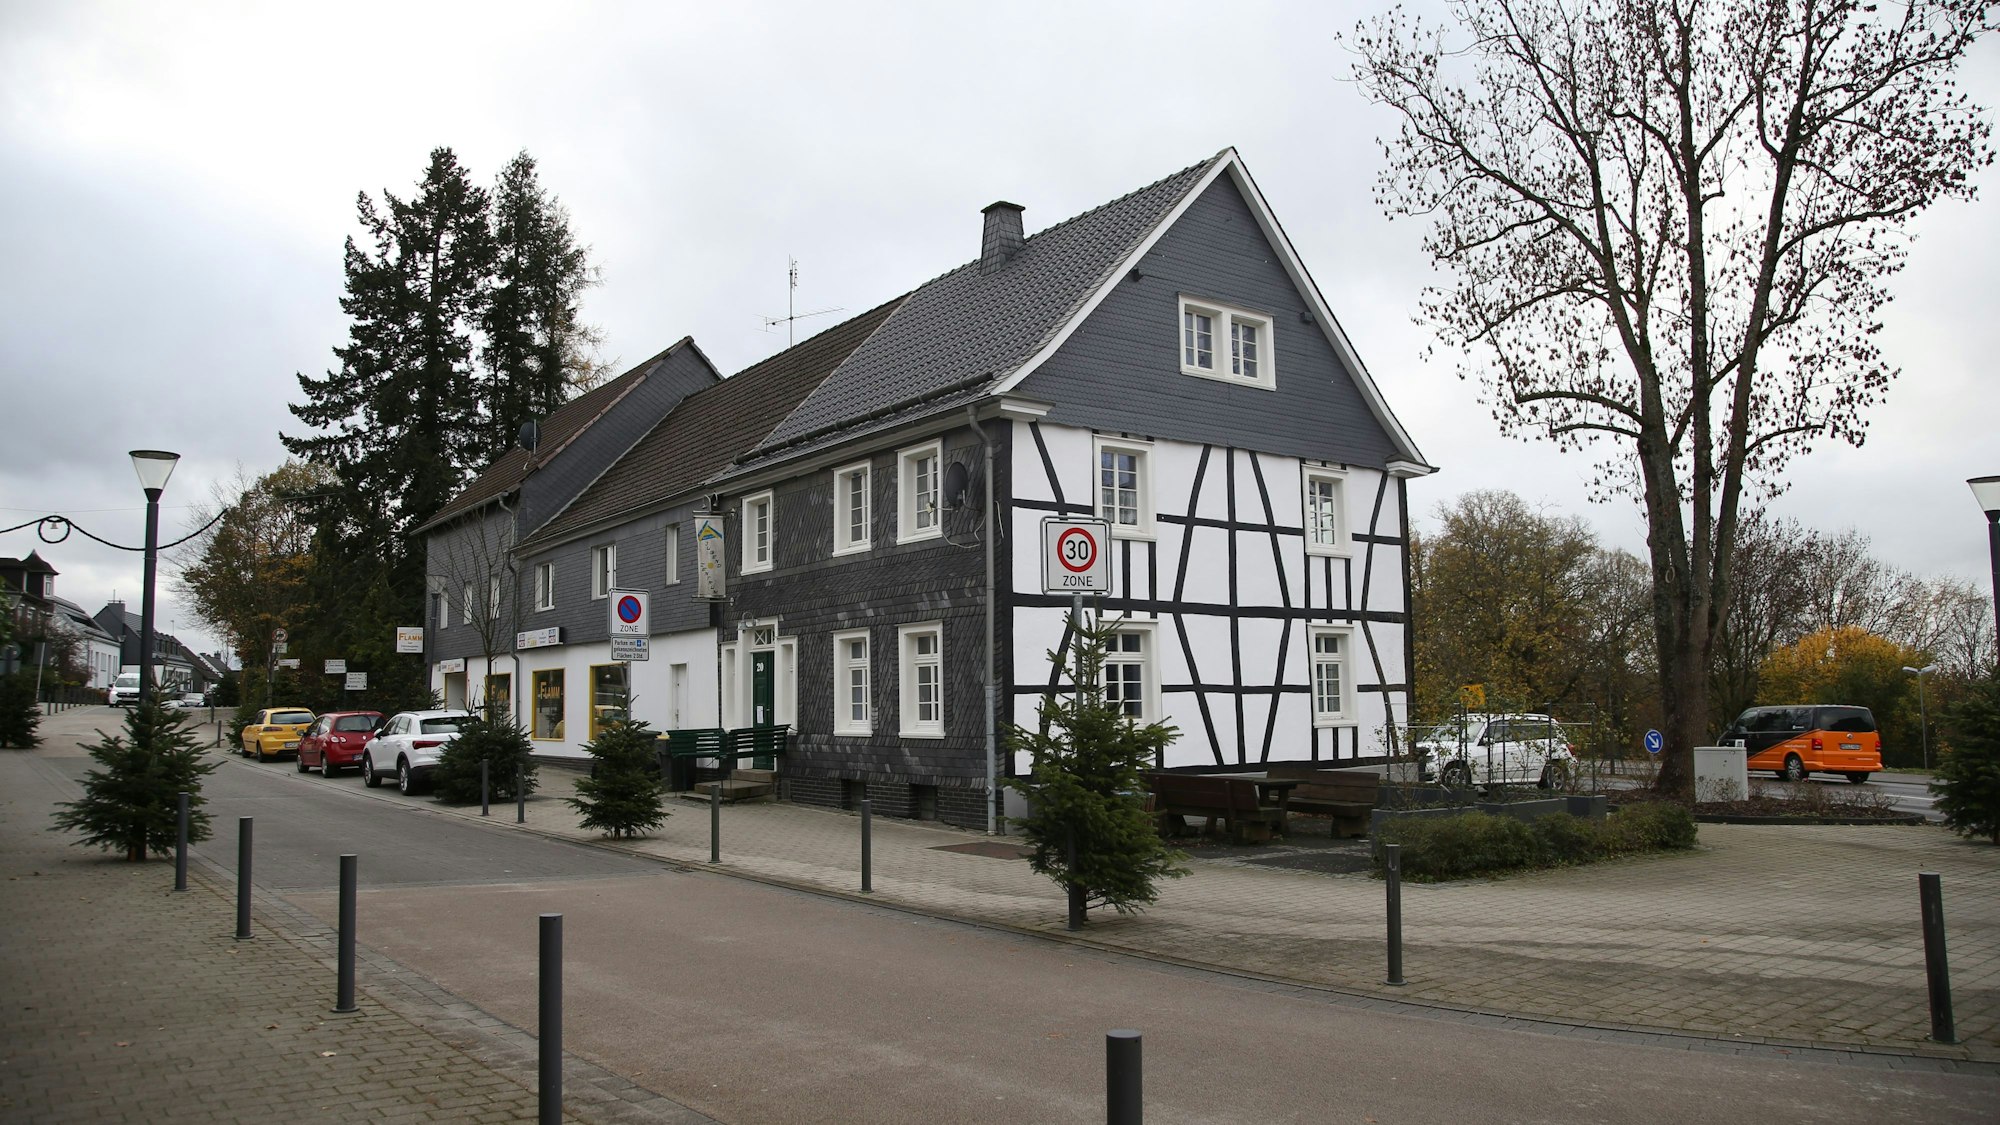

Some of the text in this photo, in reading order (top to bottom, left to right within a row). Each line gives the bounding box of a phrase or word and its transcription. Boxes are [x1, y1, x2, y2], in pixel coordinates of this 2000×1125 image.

[1066, 540, 1088, 560] 30
[1063, 575, 1093, 586] ZONE
[399, 633, 423, 641] FLAMM
[756, 662, 764, 672] 20
[540, 681, 560, 699] FLAMM
